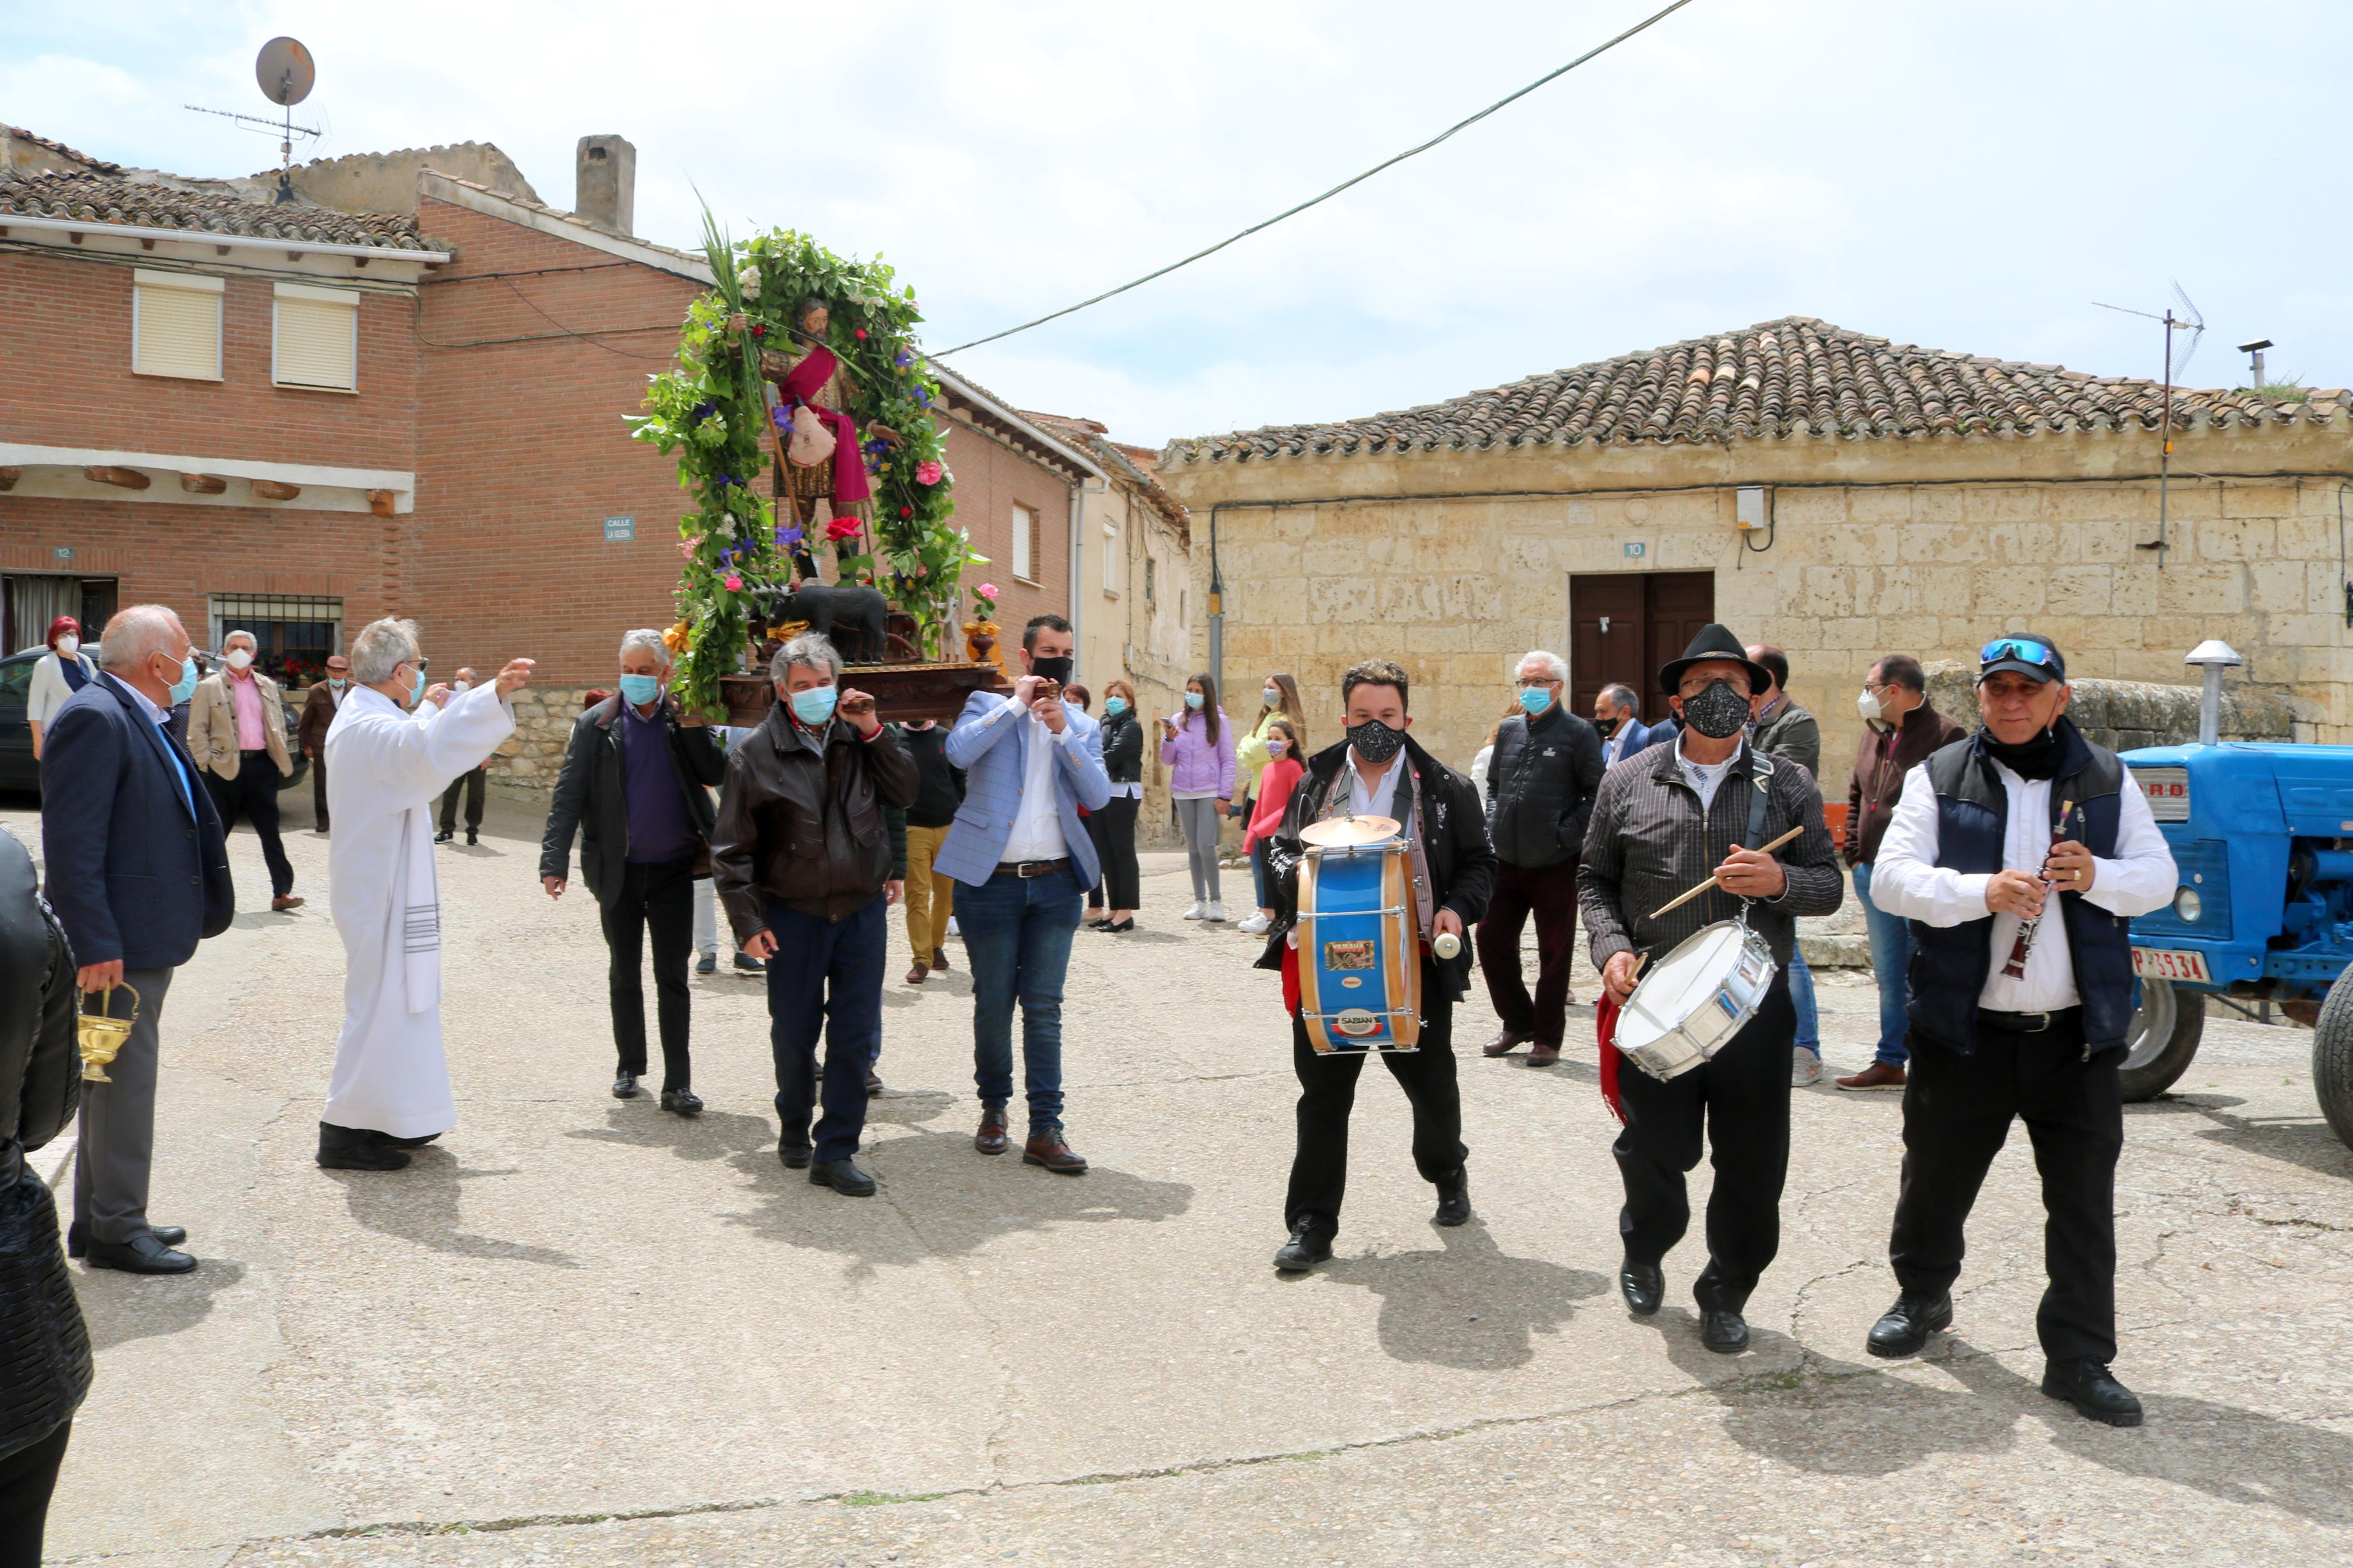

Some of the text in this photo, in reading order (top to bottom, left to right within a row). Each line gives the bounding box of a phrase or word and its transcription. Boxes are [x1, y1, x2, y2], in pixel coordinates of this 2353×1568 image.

[57, 549, 69, 557] 12
[1628, 544, 1641, 555] 10
[2138, 783, 2185, 797] RD
[2155, 952, 2203, 980] 3934
